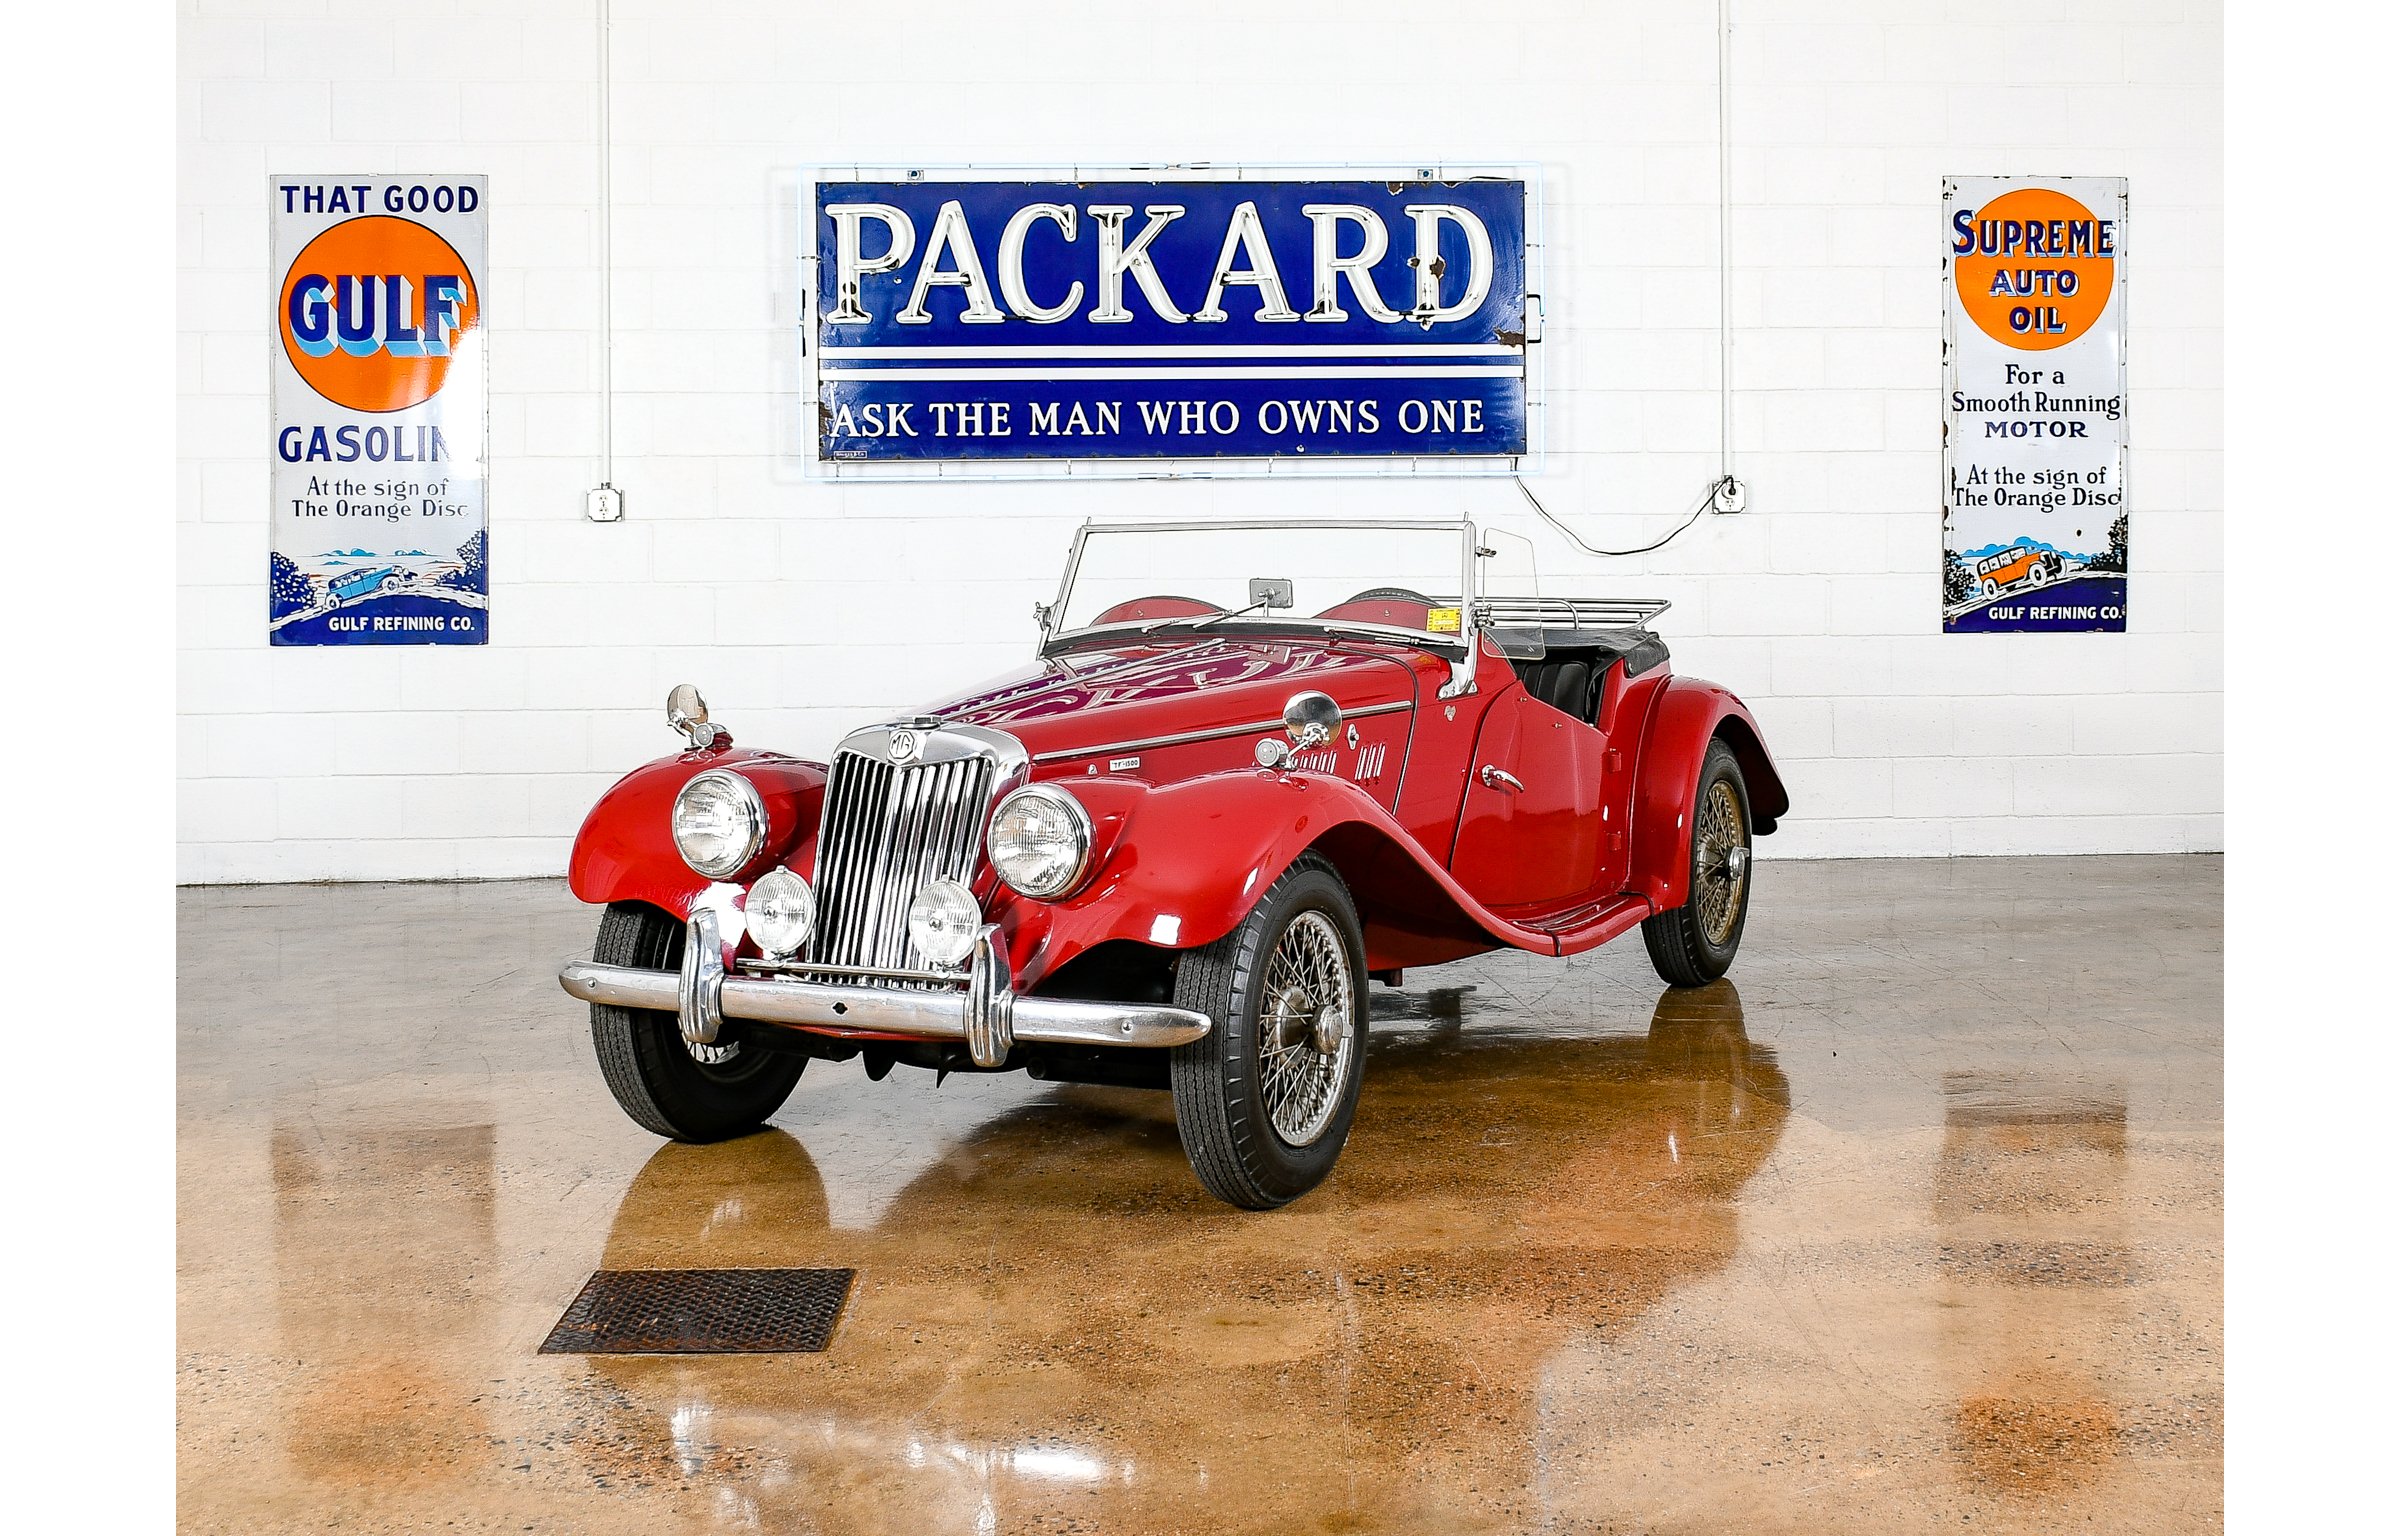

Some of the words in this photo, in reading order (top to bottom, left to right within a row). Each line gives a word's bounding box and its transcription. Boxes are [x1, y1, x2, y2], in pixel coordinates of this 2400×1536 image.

[279, 185, 372, 213] THAT
[383, 184, 479, 213] GOOD
[1952, 210, 2117, 258] SUPREME
[824, 201, 1493, 324] PACKARD
[1989, 269, 2080, 297] AUTO
[288, 273, 468, 358] GULF
[2009, 306, 2067, 334] OIL
[2005, 364, 2043, 385] For
[2052, 371, 2065, 385] a
[828, 403, 919, 437] ASK
[928, 403, 1011, 436] THE
[1029, 401, 1122, 435] MAN
[1137, 401, 1240, 434] WHO
[1258, 400, 1380, 434] OWNS
[1398, 400, 1484, 433] ONE
[1952, 391, 2031, 412] Smooth
[2034, 391, 2121, 421] Running
[1984, 421, 2089, 438] MOTOR
[278, 425, 452, 462] GASOLIN
[307, 475, 330, 496] At
[334, 478, 367, 496] the
[374, 480, 420, 501] sign
[426, 477, 451, 496] of
[1966, 464, 1988, 484] At
[1994, 466, 2026, 485] the
[2033, 469, 2079, 490] sign
[2086, 466, 2107, 484] of
[291, 499, 329, 517] The
[335, 500, 412, 523] Orange
[422, 500, 469, 517] Disc
[1954, 487, 1988, 506] The
[1994, 488, 2067, 513] Orange
[2071, 487, 2119, 506] Disc
[328, 616, 369, 632] GULF
[373, 616, 445, 632] REFINING
[450, 616, 476, 632] CO.
[1988, 606, 2025, 620] GULF
[2029, 606, 2097, 620] REFINING
[2100, 606, 2123, 620] CO.
[890, 733, 912, 755] MG
